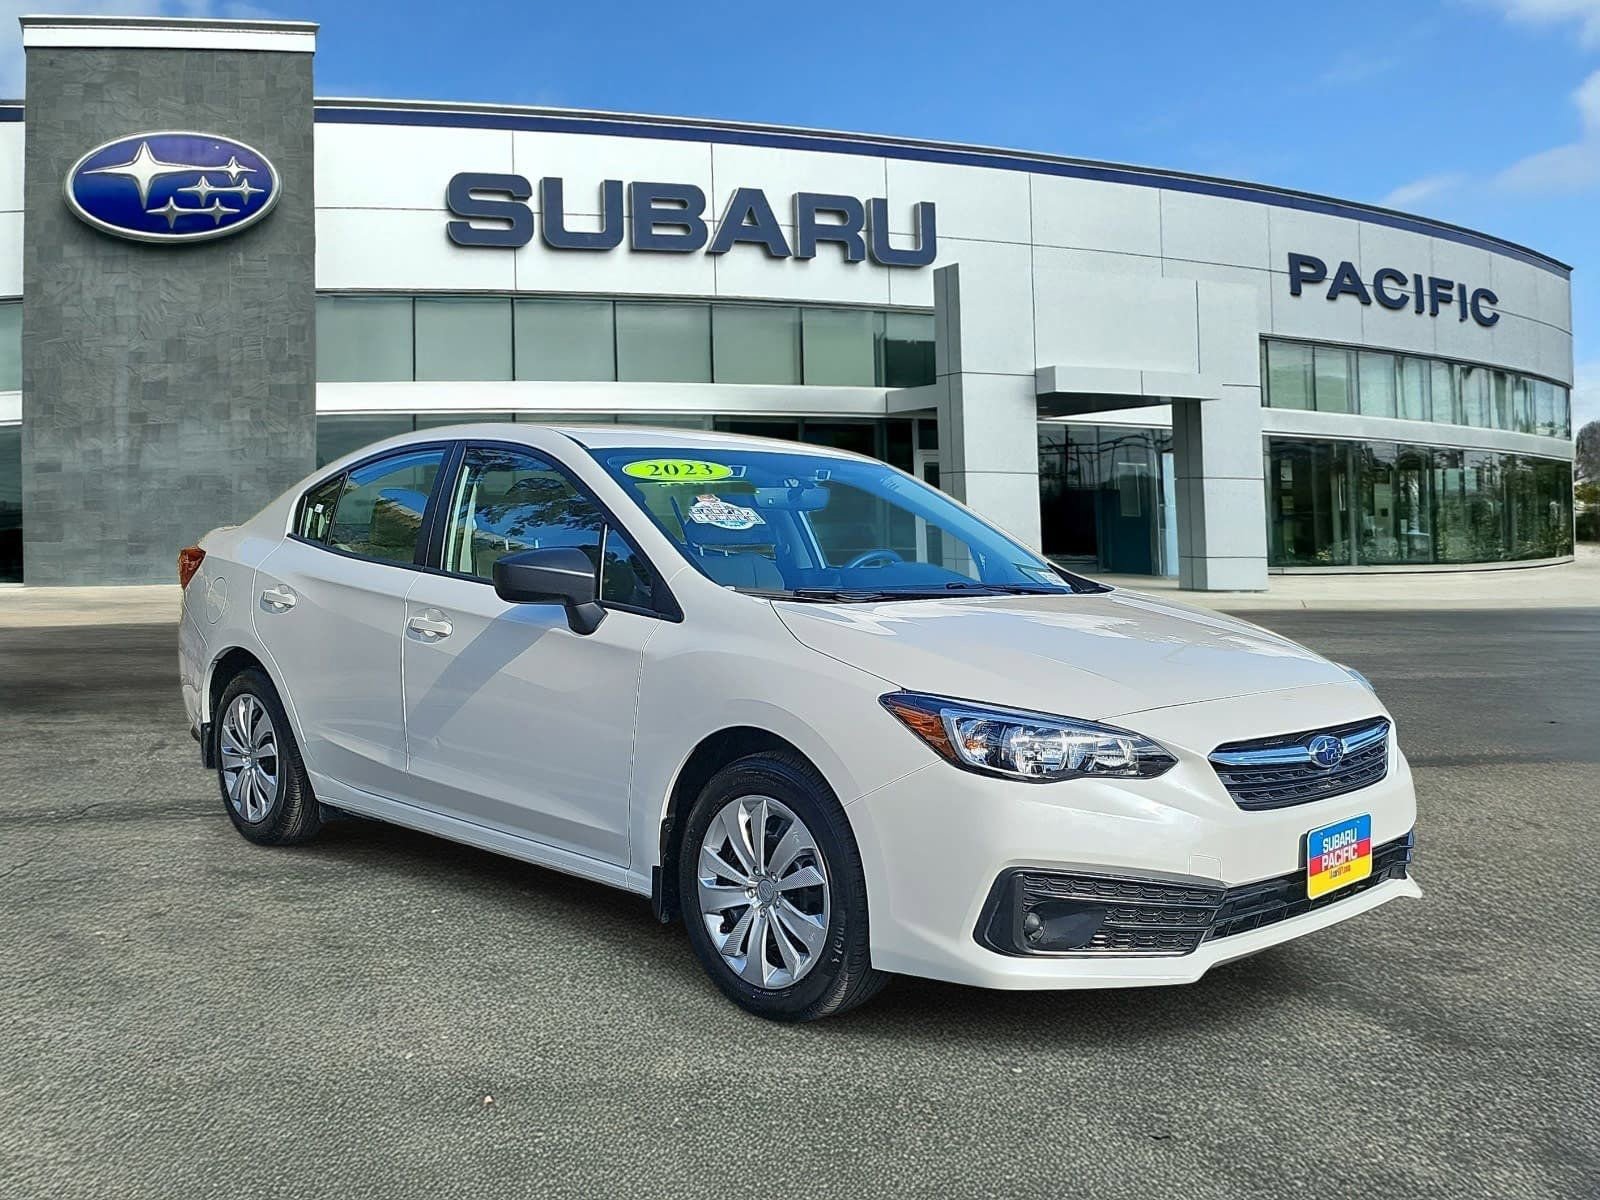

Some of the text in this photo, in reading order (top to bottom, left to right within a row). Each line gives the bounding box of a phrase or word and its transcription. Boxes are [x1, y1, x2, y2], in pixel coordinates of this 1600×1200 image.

[446, 171, 938, 268] SUBARU
[1287, 252, 1501, 328] PACIFIC
[645, 463, 714, 477] 2023
[1322, 827, 1358, 854] SUBARU
[1321, 843, 1359, 872] PACIFIC
